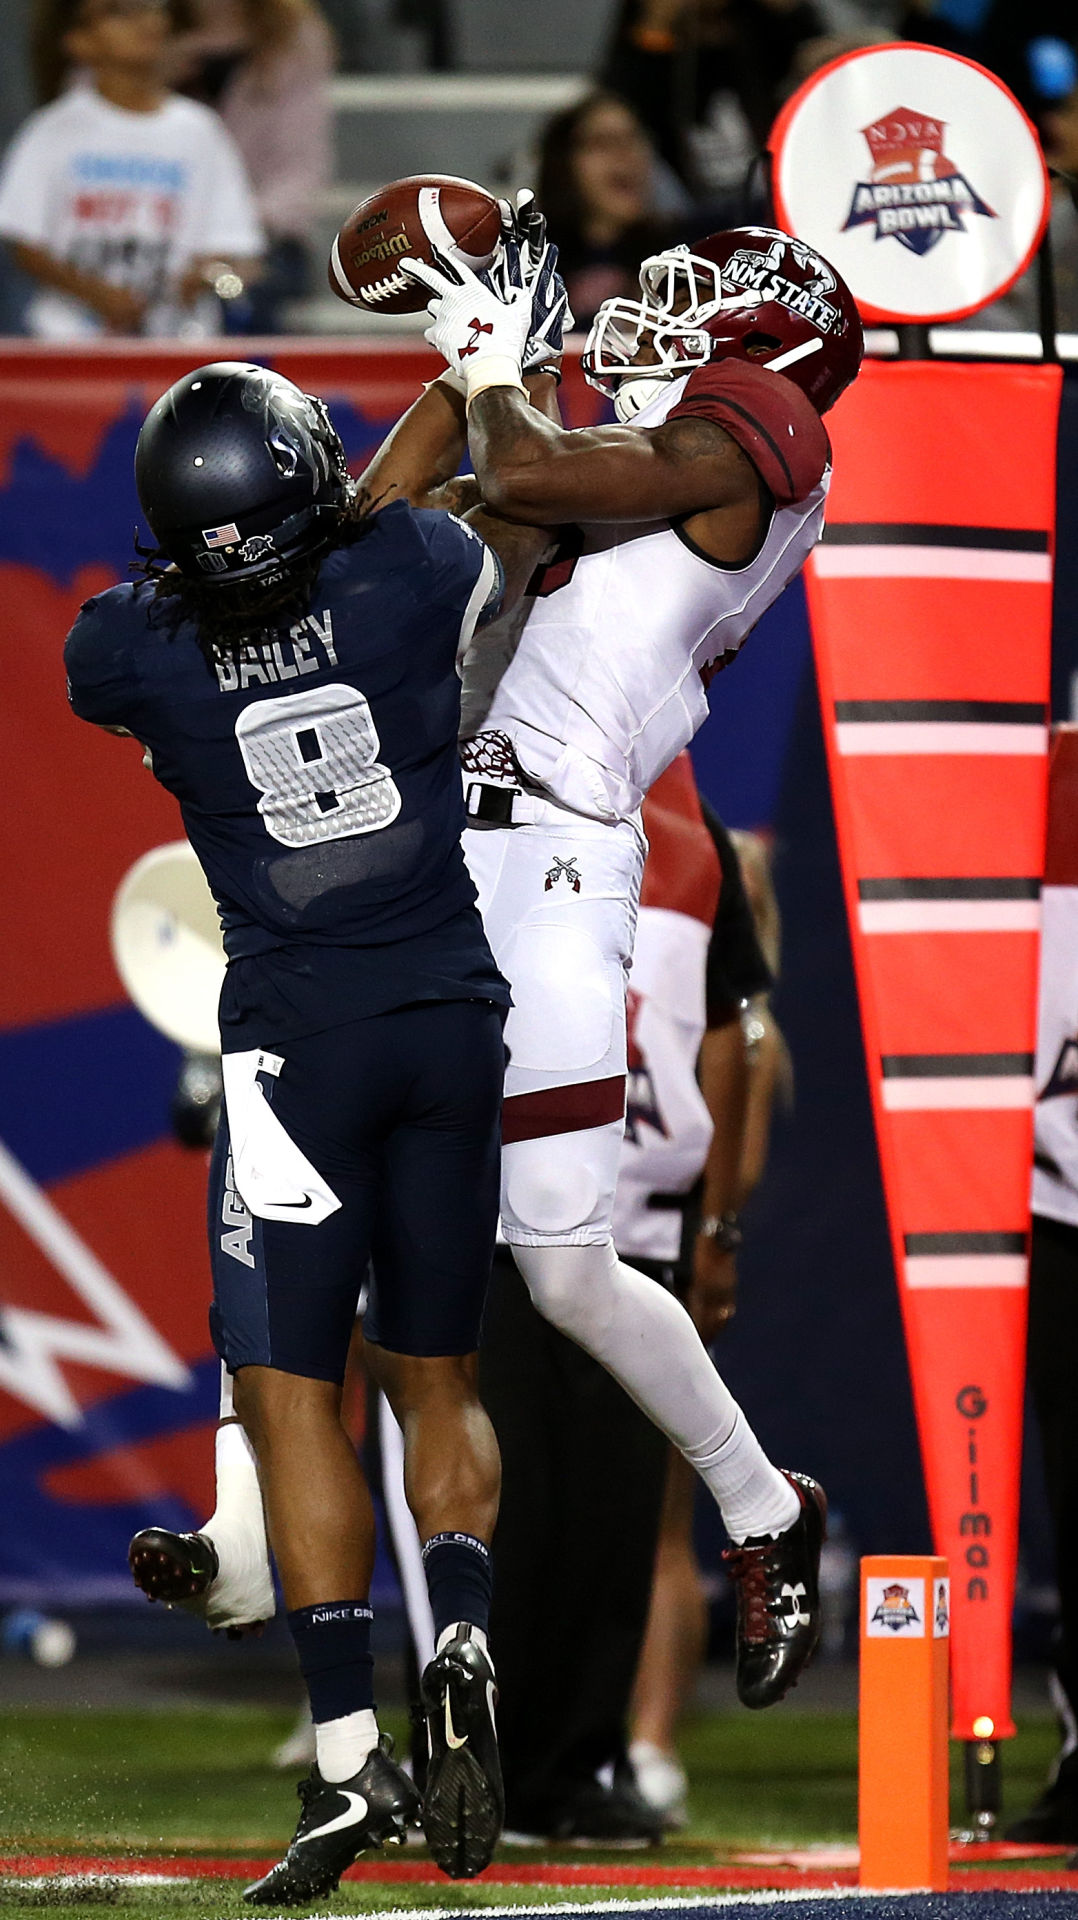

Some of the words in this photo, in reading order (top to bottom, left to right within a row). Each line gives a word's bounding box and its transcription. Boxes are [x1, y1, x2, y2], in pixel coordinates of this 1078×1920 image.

[854, 179, 973, 213] ARIZONA
[879, 203, 960, 233] BOWL
[353, 233, 413, 269] Wilson
[721, 257, 770, 290] NM
[768, 274, 837, 331] STATE
[212, 609, 339, 692] BAILEY
[235, 683, 402, 848] 8
[956, 1385, 992, 1601] Gilman
[312, 1608, 350, 1624] NIKE
